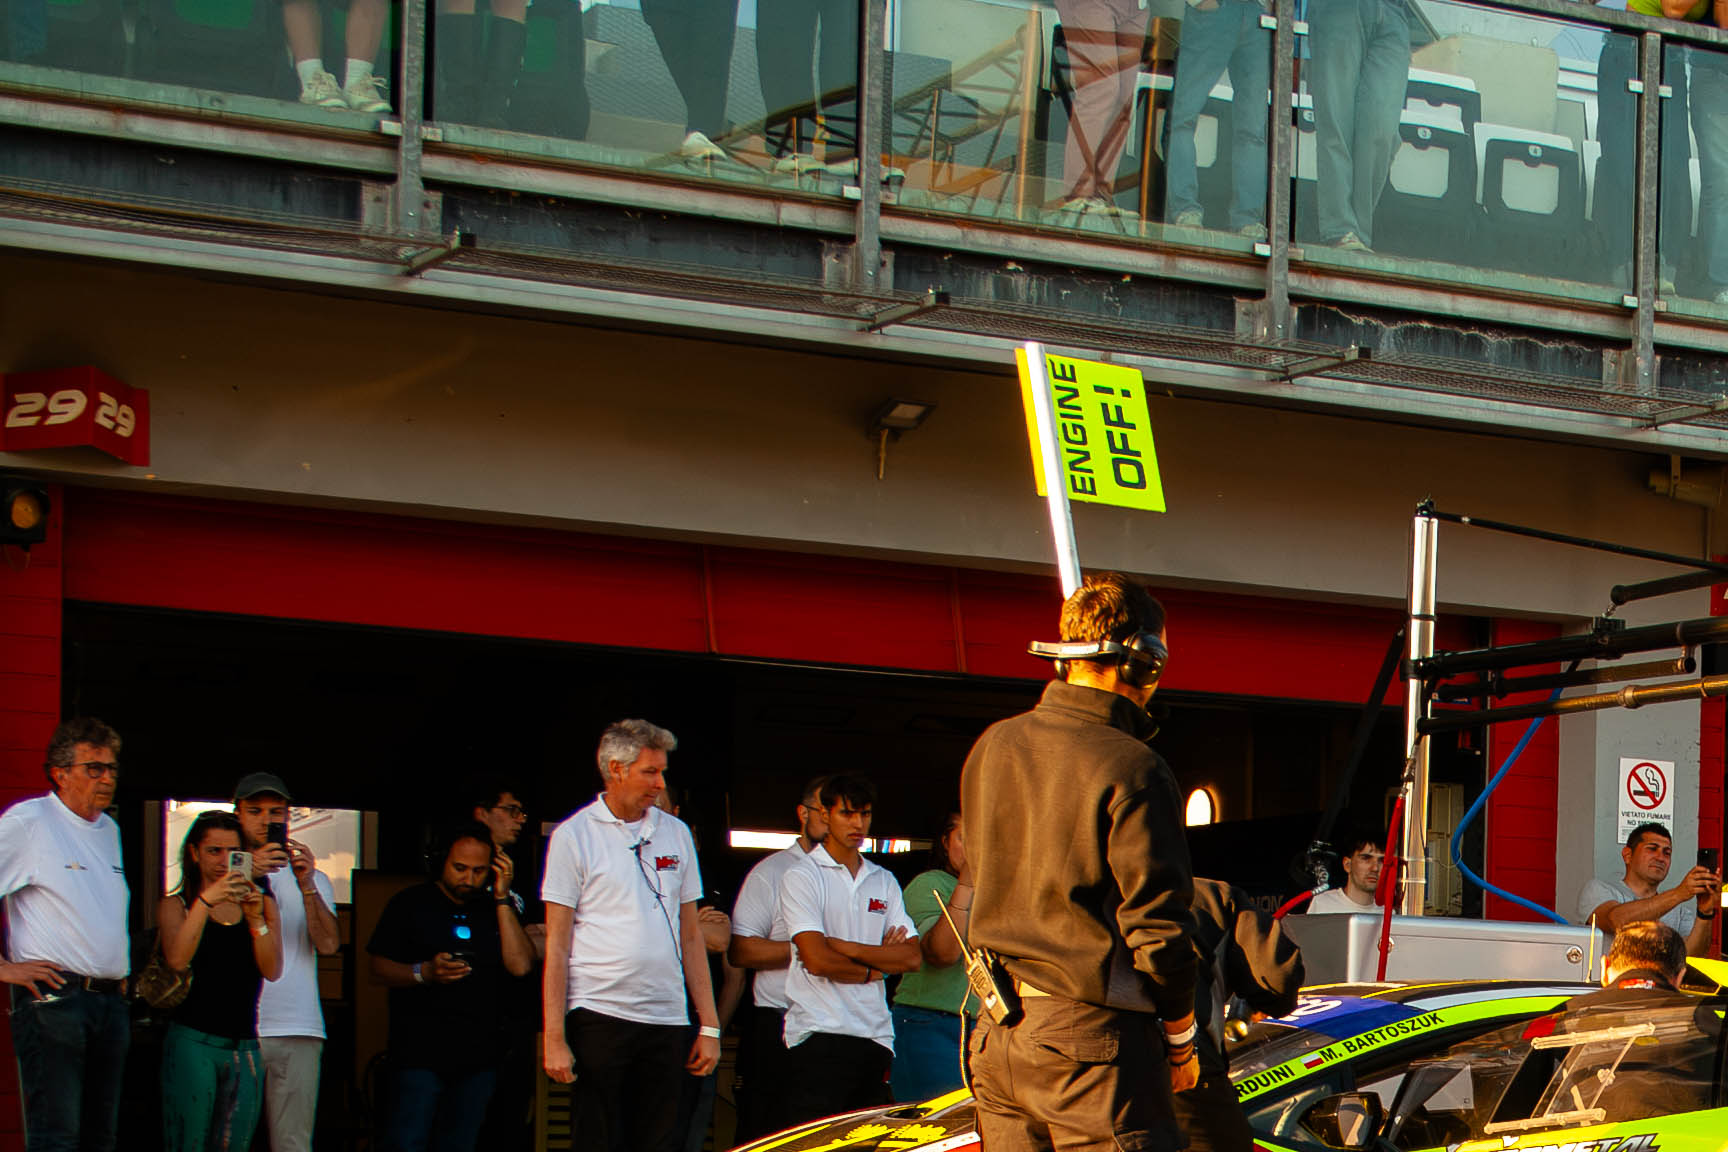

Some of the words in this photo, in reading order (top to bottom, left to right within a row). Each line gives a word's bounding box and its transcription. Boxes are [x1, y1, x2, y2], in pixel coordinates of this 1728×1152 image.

[5, 389, 88, 428] 29
[94, 391, 136, 438] 29
[1048, 358, 1098, 496] ENGINE
[1093, 384, 1147, 490] OFF!
[1621, 811, 1646, 819] VIETATO
[1646, 812, 1671, 820] FUMARE
[1320, 1047, 1344, 1063] M.
[1344, 1012, 1445, 1054] BARTOSZUK
